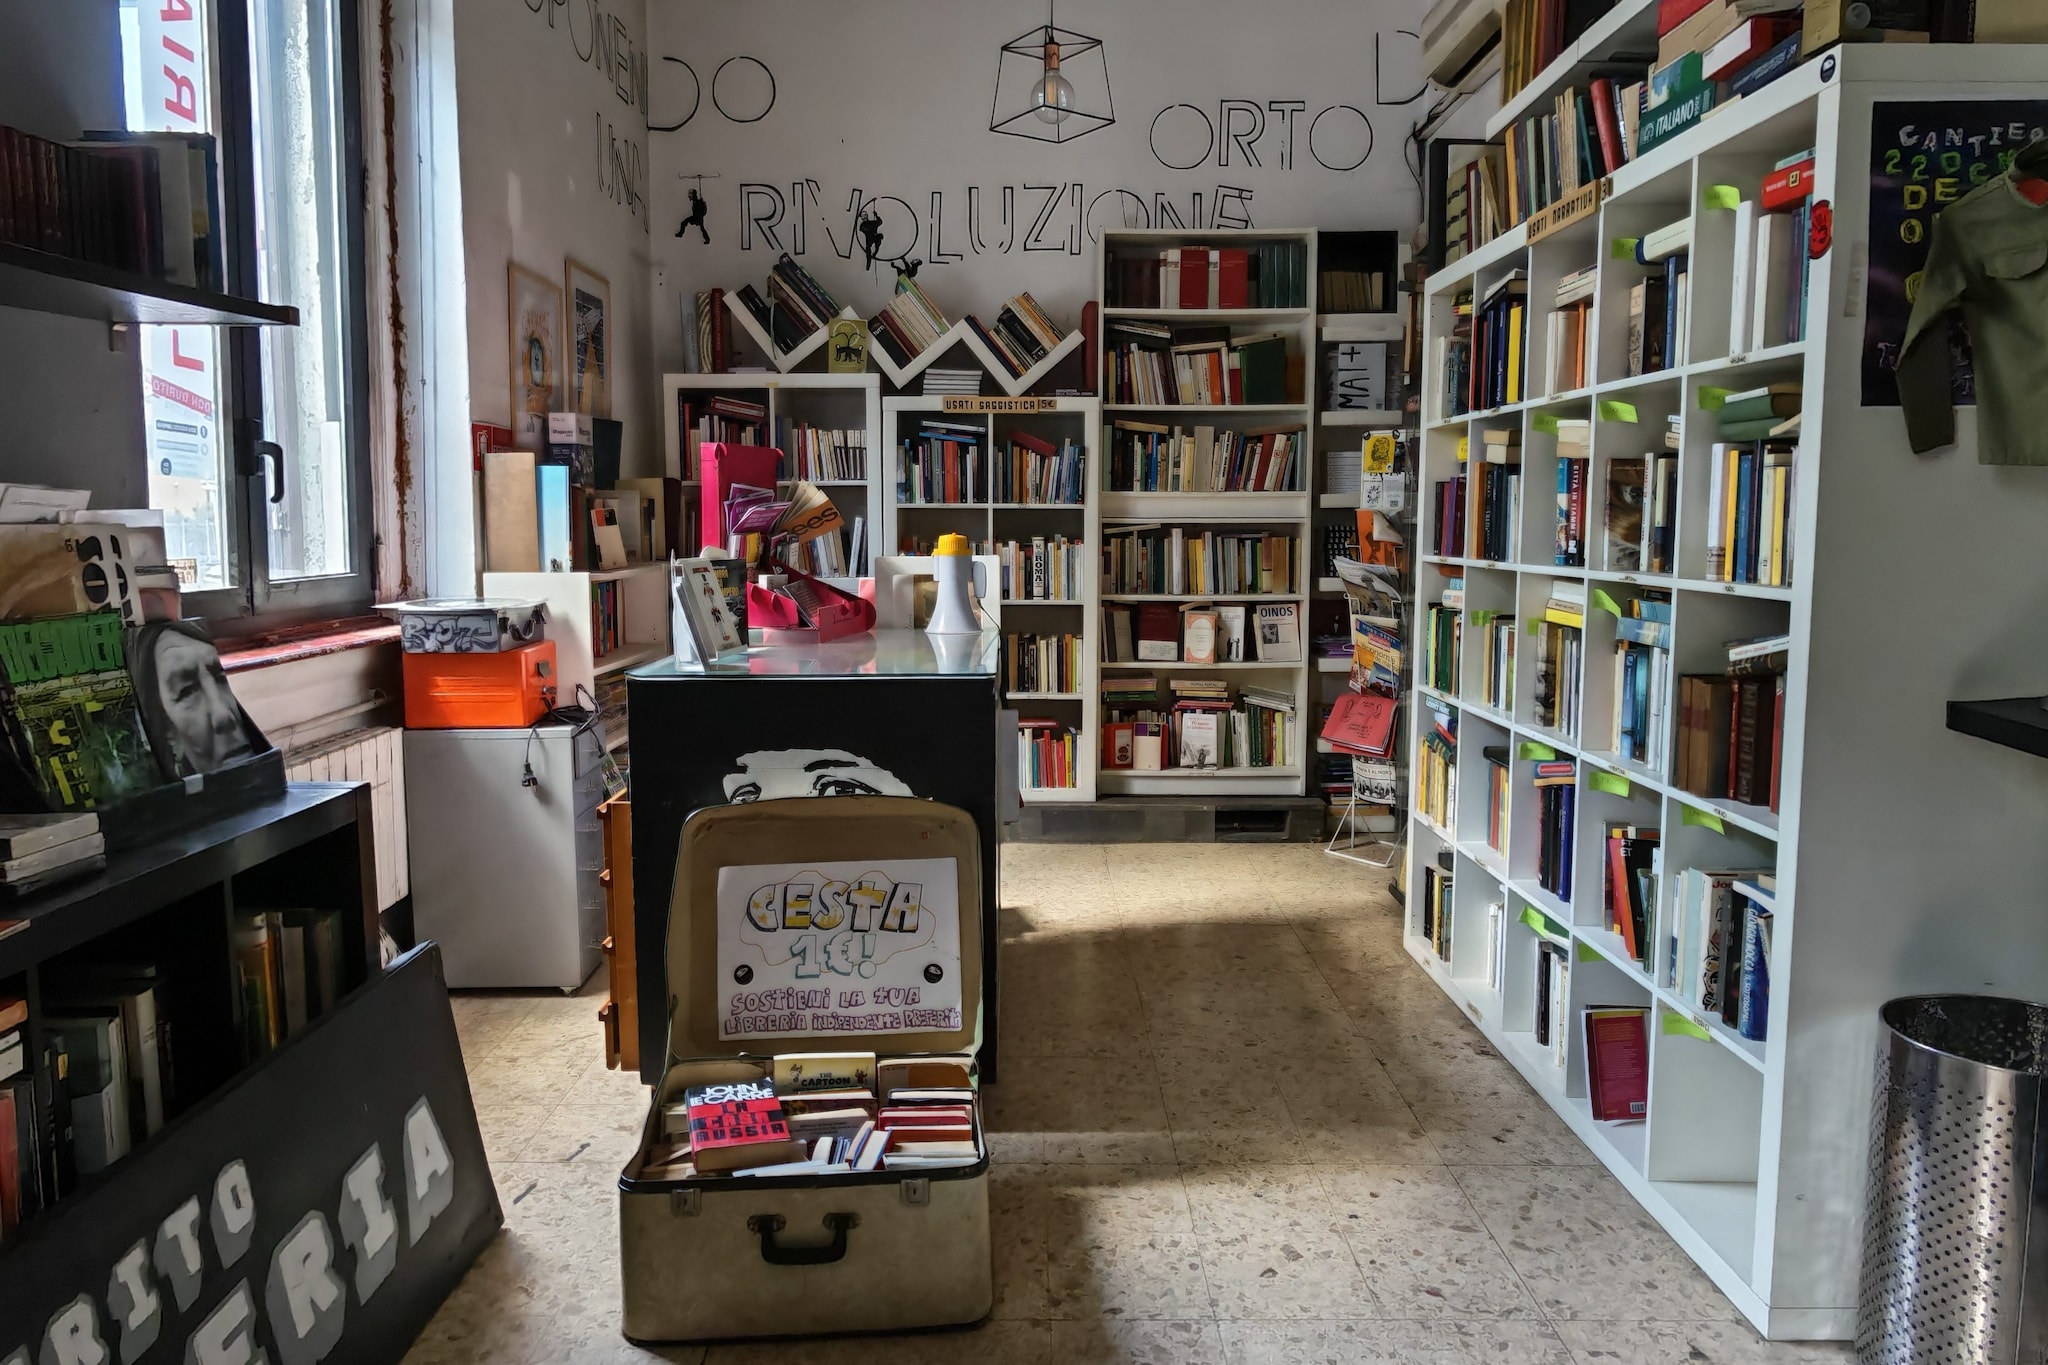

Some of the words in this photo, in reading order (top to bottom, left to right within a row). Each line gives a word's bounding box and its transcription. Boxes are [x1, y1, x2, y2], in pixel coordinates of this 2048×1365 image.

[1655, 98, 1695, 138] ITALIANO
[946, 400, 974, 410] USATI
[979, 400, 1035, 410] SAGGISTICA
[782, 506, 838, 536] ees
[1035, 555, 1043, 582] ROMA
[1261, 606, 1293, 618] OINOS
[746, 880, 923, 933] CESTA
[839, 990, 866, 1008] LA
[701, 1083, 760, 1098] JOHN
[800, 1077, 852, 1087] CARTOON
[721, 1102, 750, 1114] LA
[705, 1112, 771, 1128] CASA
[695, 1122, 786, 1143] RUSSIA
[0, 1158, 257, 1365] RITO
